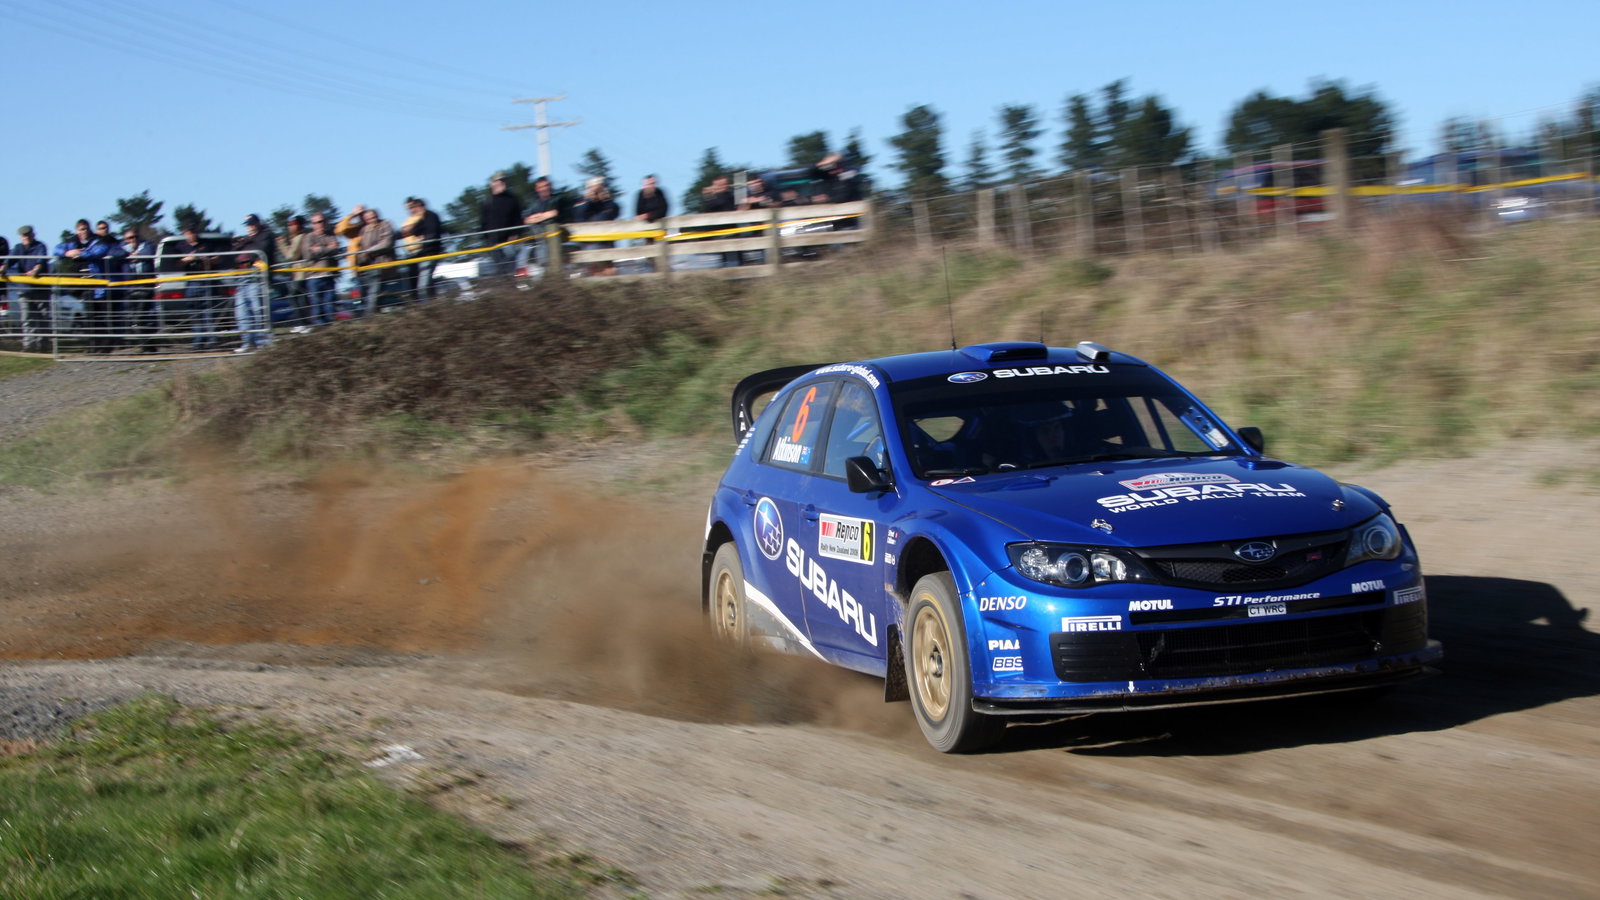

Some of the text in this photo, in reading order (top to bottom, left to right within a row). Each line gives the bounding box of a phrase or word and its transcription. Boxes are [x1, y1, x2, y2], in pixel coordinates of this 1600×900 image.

[993, 365, 1110, 378] SUBARU
[792, 386, 817, 443] 6
[772, 436, 802, 464] Atkinson
[1097, 483, 1297, 508] SUBARU
[1108, 498, 1179, 513] WORLD
[1187, 491, 1244, 502] RALLY
[835, 521, 860, 543] Repco
[863, 522, 871, 561] 6
[786, 537, 878, 647] SUBARU
[1351, 579, 1386, 594] MOTUL
[979, 596, 1027, 611] DENSO
[1213, 592, 1320, 607] STI Performance
[1393, 586, 1424, 605] PIRELL
[1128, 599, 1174, 611] MOTUL
[1264, 604, 1285, 614] WRC
[1061, 615, 1122, 632] PIRELLI
[993, 656, 1024, 671] BBS
